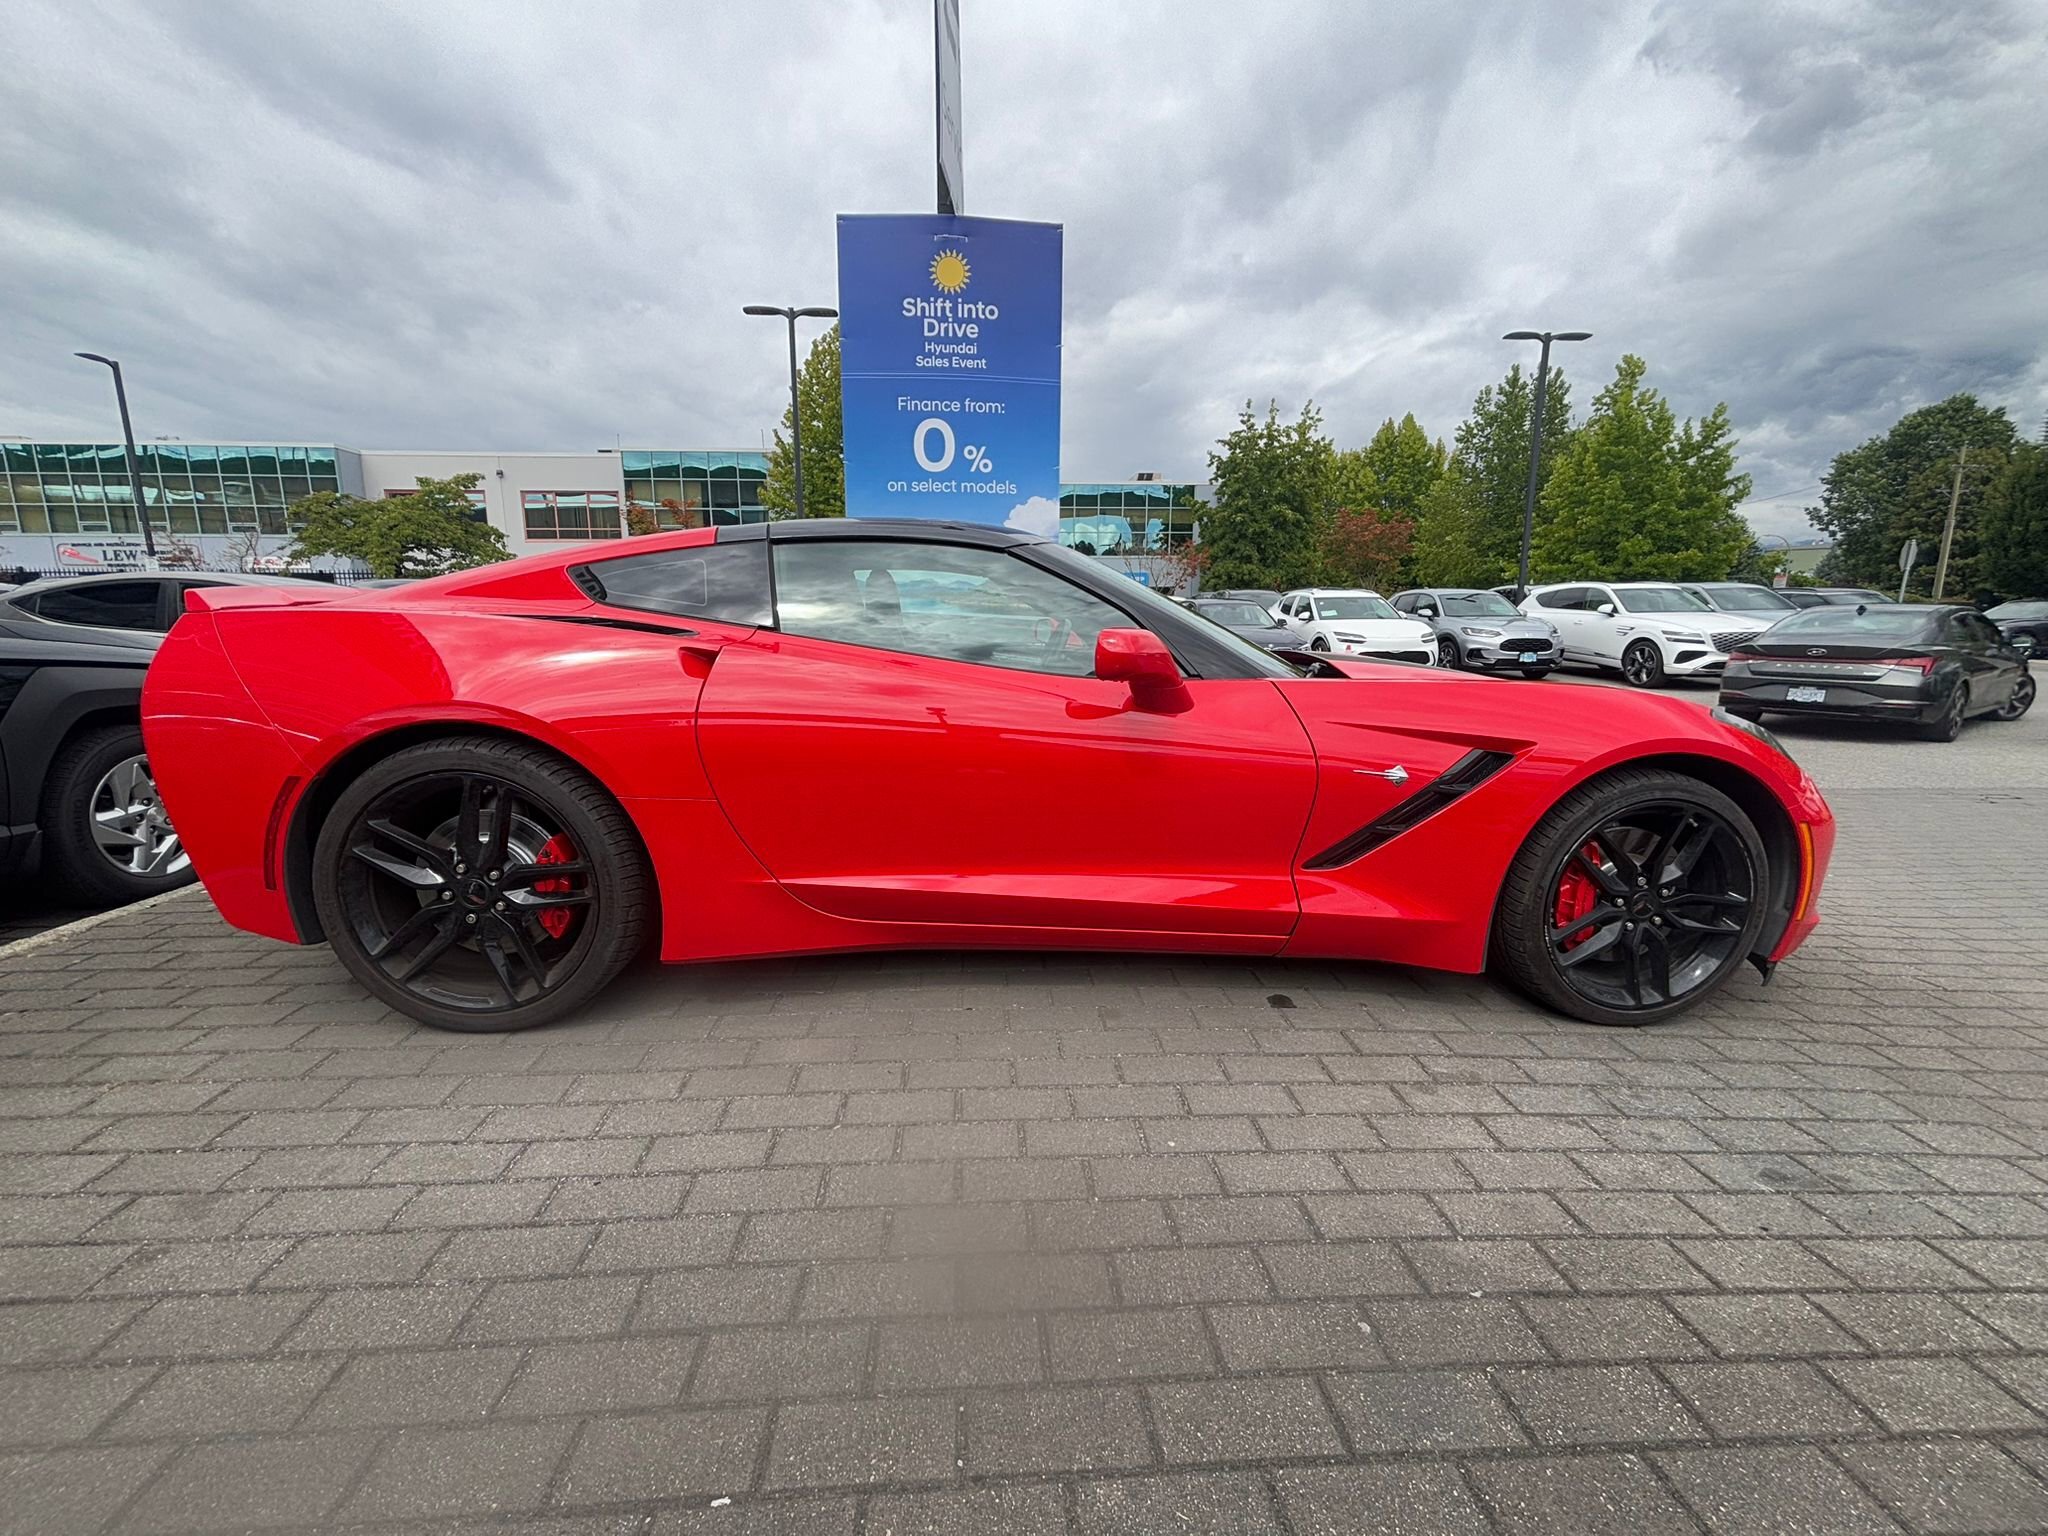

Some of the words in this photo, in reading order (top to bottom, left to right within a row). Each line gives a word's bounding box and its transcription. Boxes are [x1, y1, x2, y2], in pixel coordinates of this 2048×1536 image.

[902, 297, 953, 317] Shift
[958, 298, 999, 320] into
[923, 318, 979, 338] Drive
[925, 342, 977, 355] Hyundai
[916, 355, 949, 367] Sales
[952, 356, 987, 369] Event
[898, 396, 960, 412] Finance
[964, 397, 1005, 414] from:
[913, 417, 956, 473] 0
[963, 445, 993, 473] %
[887, 481, 907, 492] on
[911, 478, 957, 492] select
[961, 480, 1017, 495] models
[102, 550, 137, 561] LEW
